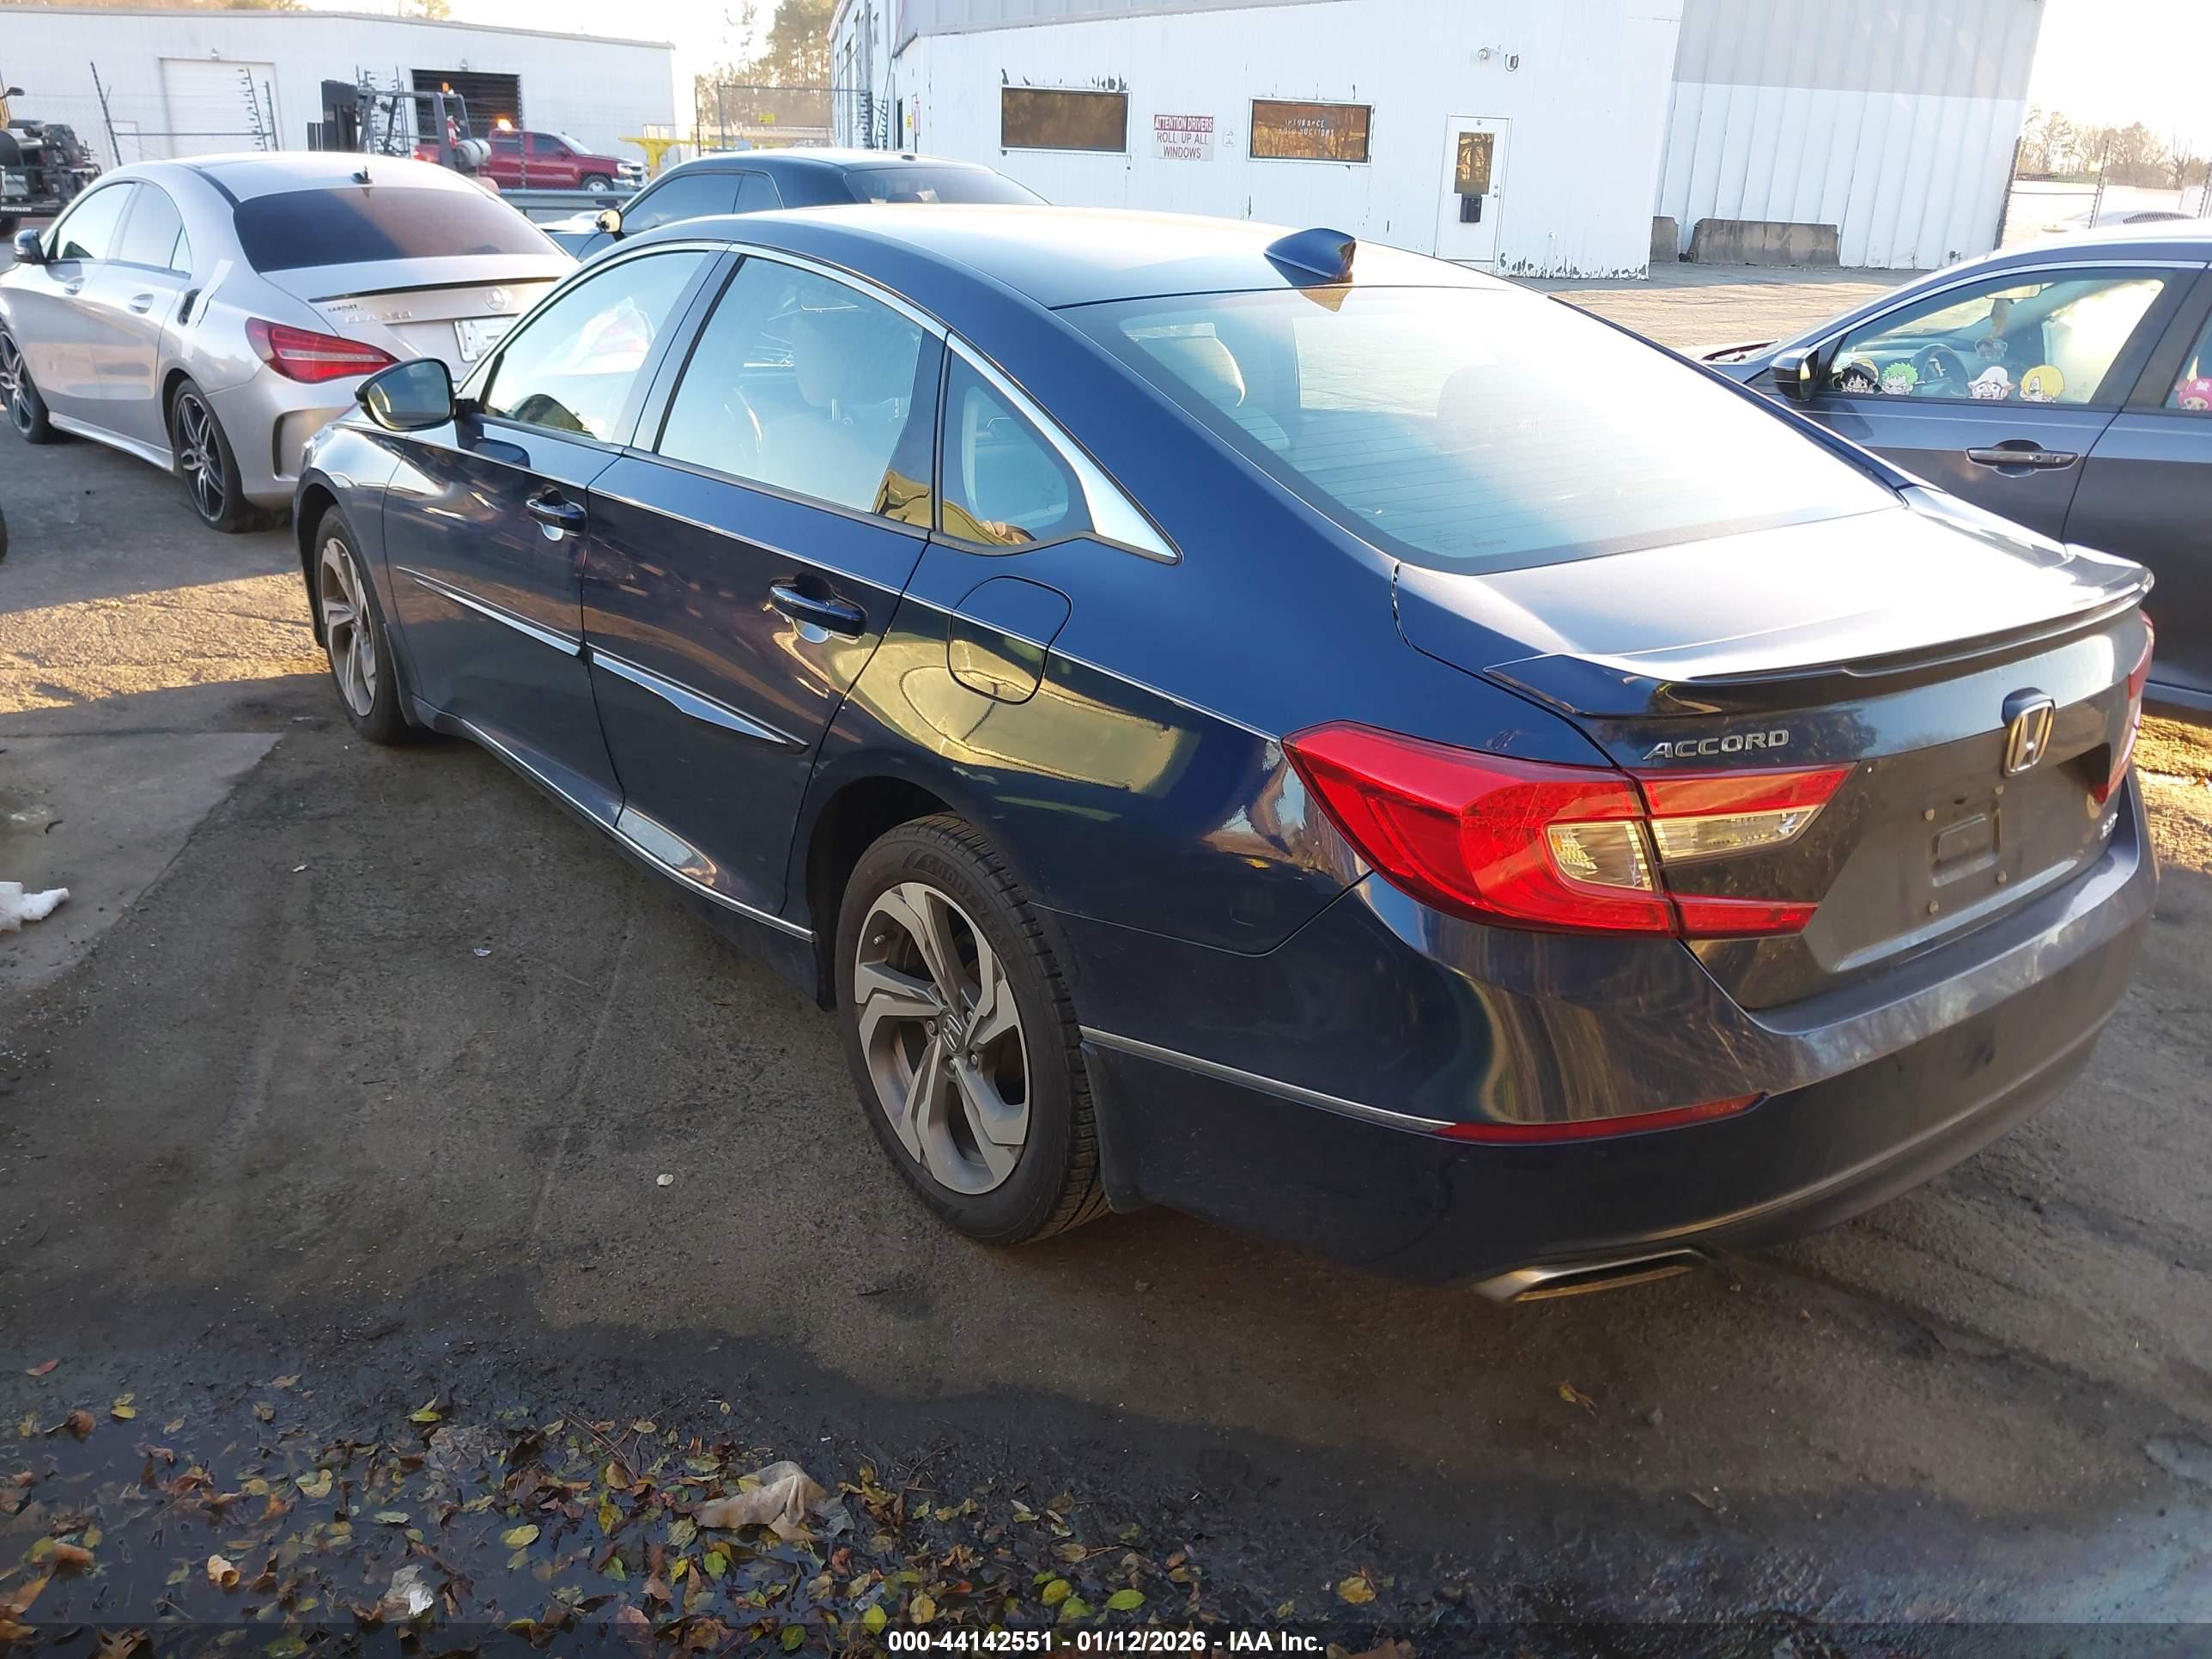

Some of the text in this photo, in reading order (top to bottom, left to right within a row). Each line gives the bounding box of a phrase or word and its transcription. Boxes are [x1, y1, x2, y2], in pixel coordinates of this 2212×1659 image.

[1154, 115, 1213, 132] ATTENTION DRIVERS
[1157, 132, 1209, 145] ROLL UP ALL
[1163, 146, 1201, 159] WINDOWS
[1642, 729, 1790, 761] ACCORD
